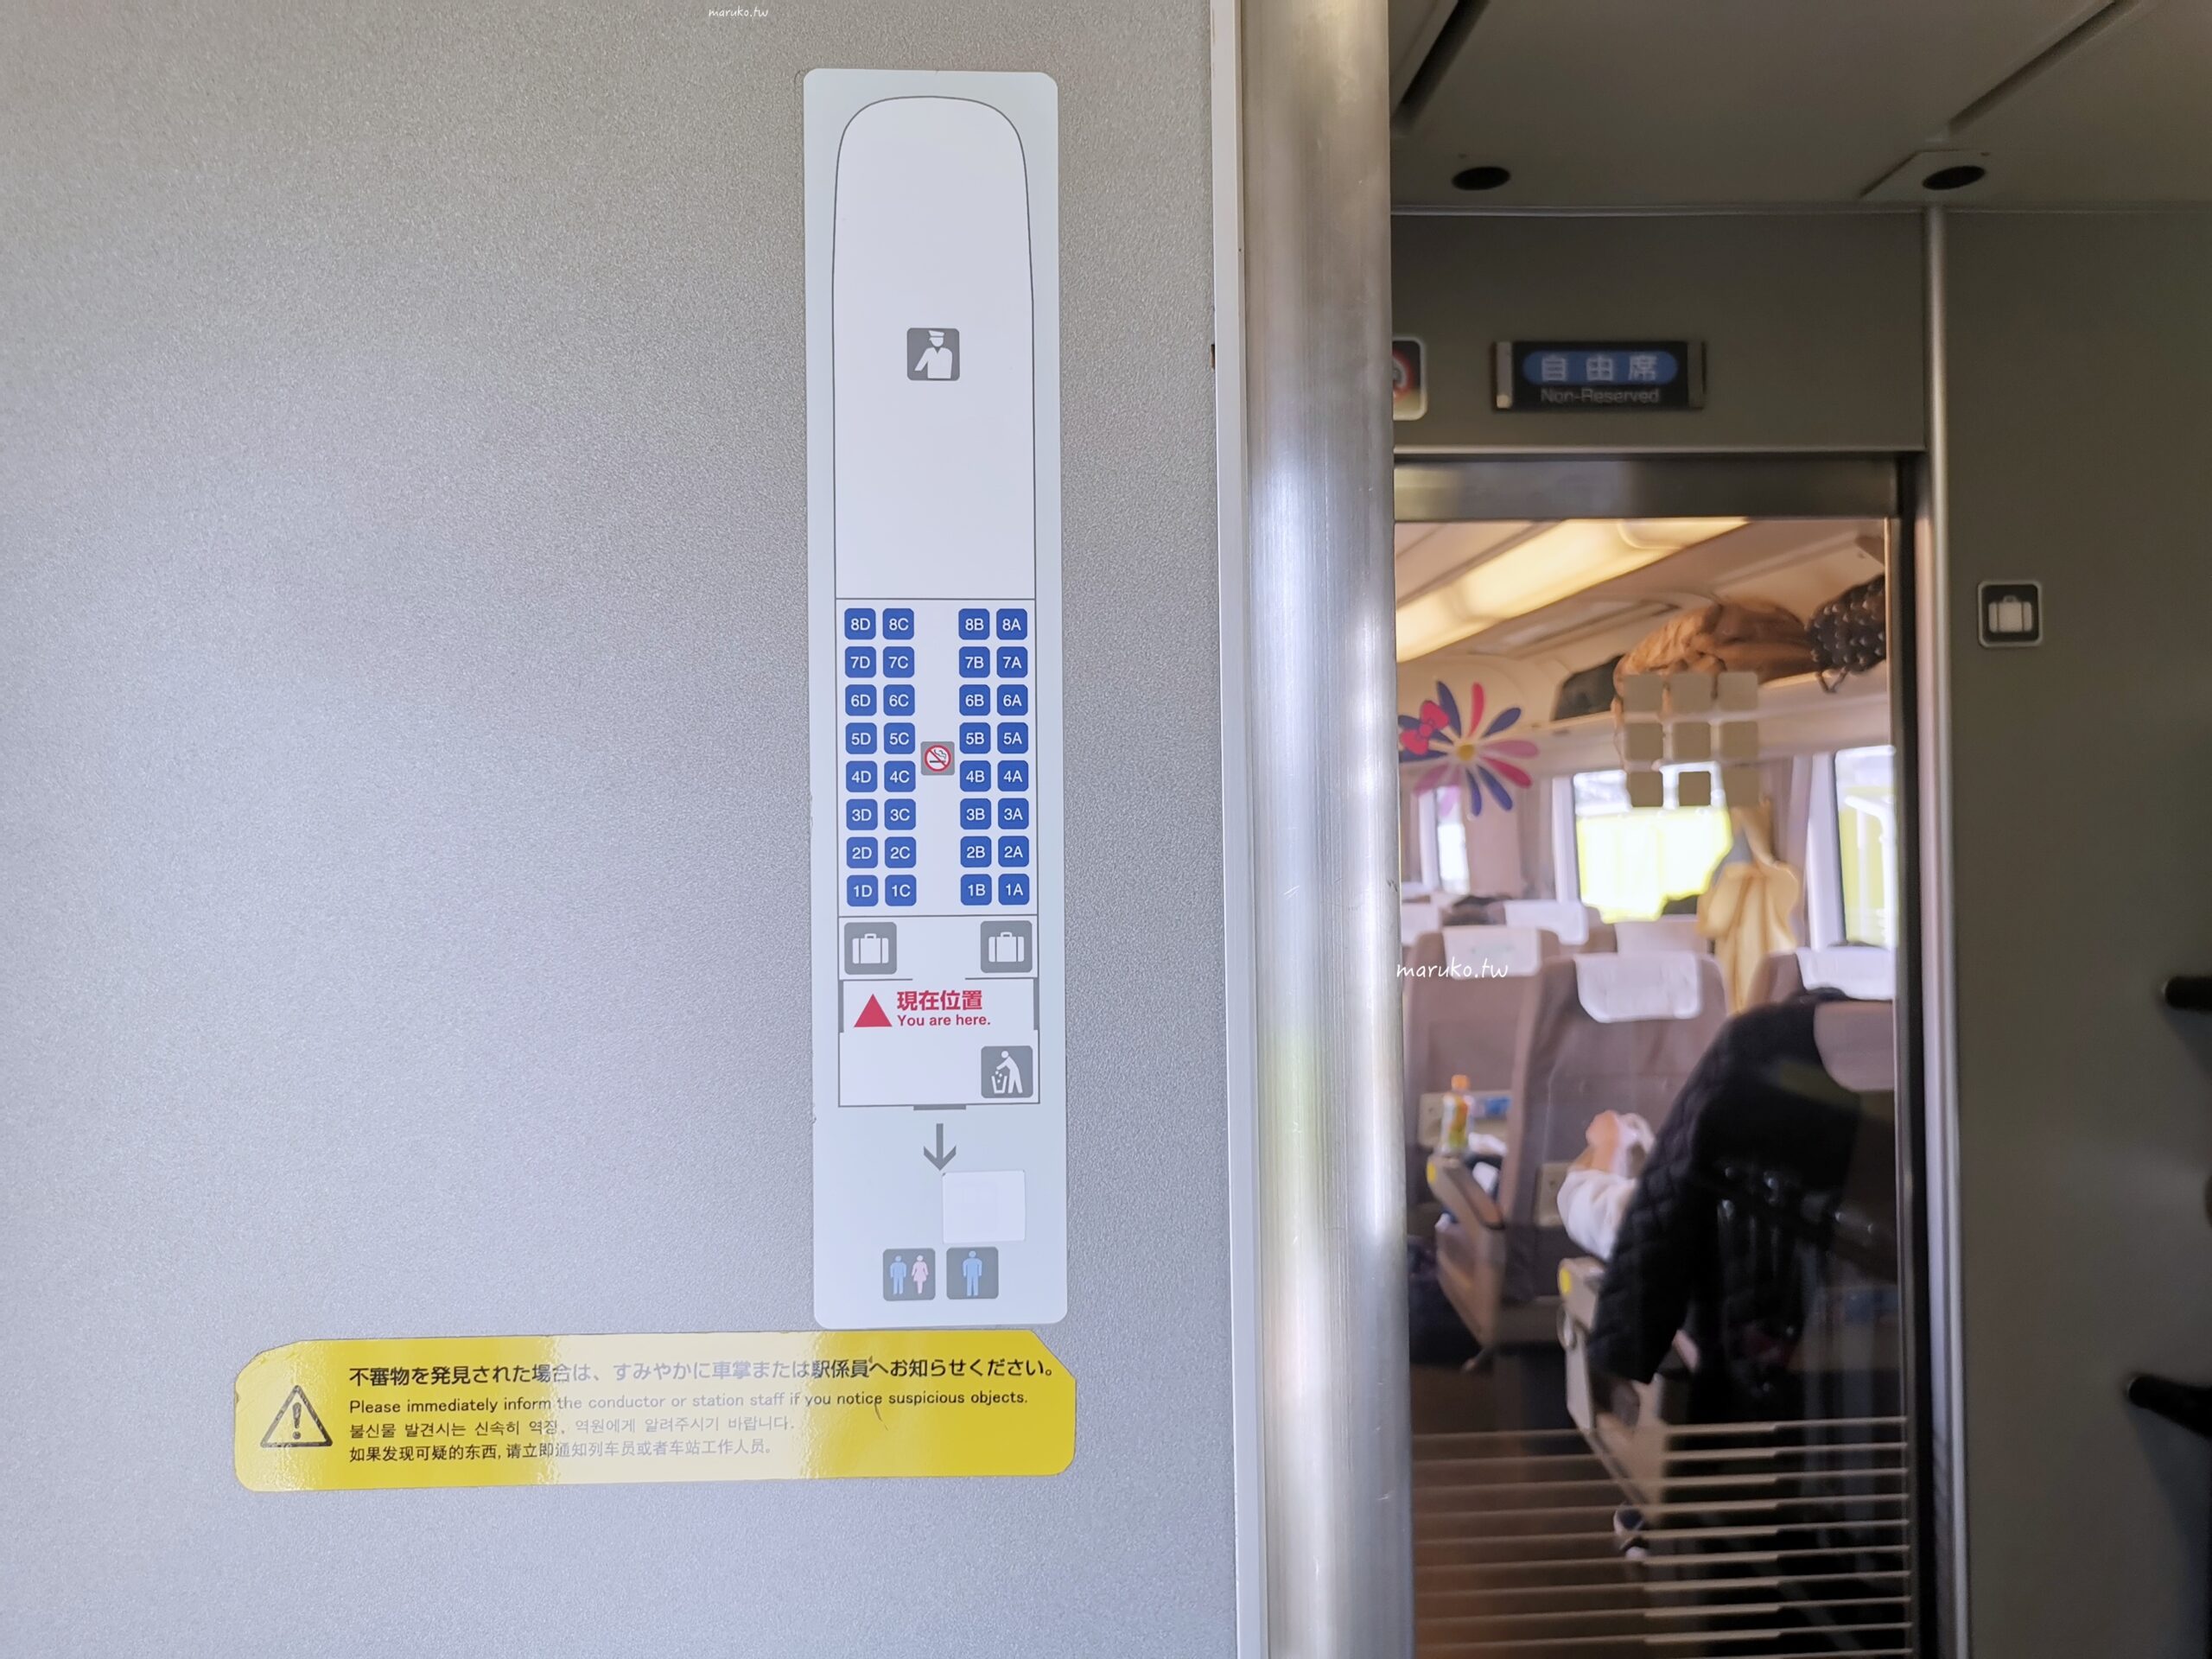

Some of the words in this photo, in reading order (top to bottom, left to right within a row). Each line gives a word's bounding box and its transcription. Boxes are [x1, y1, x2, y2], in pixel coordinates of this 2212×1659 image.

[1541, 354, 1657, 381] 自由席
[1541, 388, 1660, 404] Non-Reserved
[850, 617, 871, 631] 8D
[888, 617, 909, 631] 8C
[964, 618, 984, 632] 8B
[1002, 618, 1022, 632] 8A
[850, 655, 871, 669] 7D
[888, 655, 909, 670] 7C
[964, 656, 984, 669] 7B
[1002, 656, 1022, 669] 7A
[850, 693, 871, 708] 6D
[888, 693, 909, 708] 6C
[965, 694, 985, 708] 6B
[1002, 694, 1022, 707] 6A
[851, 732, 872, 746] 5D
[889, 732, 910, 746] 5C
[965, 731, 985, 746] 5B
[1003, 731, 1023, 745] 5A
[851, 770, 872, 784] 4D
[889, 770, 910, 784] 4C
[965, 770, 985, 783] 4B
[1003, 770, 1023, 783] 4A
[851, 808, 873, 822] 3D
[890, 808, 911, 822] 3C
[966, 807, 986, 822] 3B
[1003, 807, 1024, 821] 3A
[851, 846, 873, 860] 2D
[890, 846, 911, 860] 2C
[966, 845, 986, 859] 2B
[1004, 845, 1024, 858] 2A
[853, 884, 873, 898] 1D
[891, 884, 911, 898] 1C
[968, 883, 986, 897] 1B
[1005, 882, 1024, 896] 1A
[897, 990, 982, 1011] 現在位置
[897, 1014, 925, 1027] You
[929, 1017, 951, 1026] are
[956, 1014, 990, 1026] here.
[349, 1358, 1053, 1387] 不審物を発見された場合は、すみやかに車掌または駅係員へお知らせください。
[349, 1400, 401, 1414] Please
[407, 1398, 499, 1413] immediately
[504, 1398, 551, 1411] inform
[557, 1396, 582, 1410] the
[588, 1395, 666, 1408] conductor
[671, 1397, 687, 1408] or
[692, 1393, 744, 1407] station
[750, 1392, 785, 1406] staff
[790, 1392, 800, 1405] if
[804, 1395, 831, 1407] you
[836, 1391, 882, 1404] notice
[888, 1390, 965, 1406] suspicious
[970, 1389, 1028, 1406] objects.
[350, 1424, 396, 1439] 불신물
[404, 1422, 467, 1438] 발견시는
[474, 1421, 520, 1436] 신속히
[575, 1418, 636, 1433] 역원에게
[645, 1416, 720, 1433] 알려주시기
[728, 1414, 795, 1431] 바랍니다.
